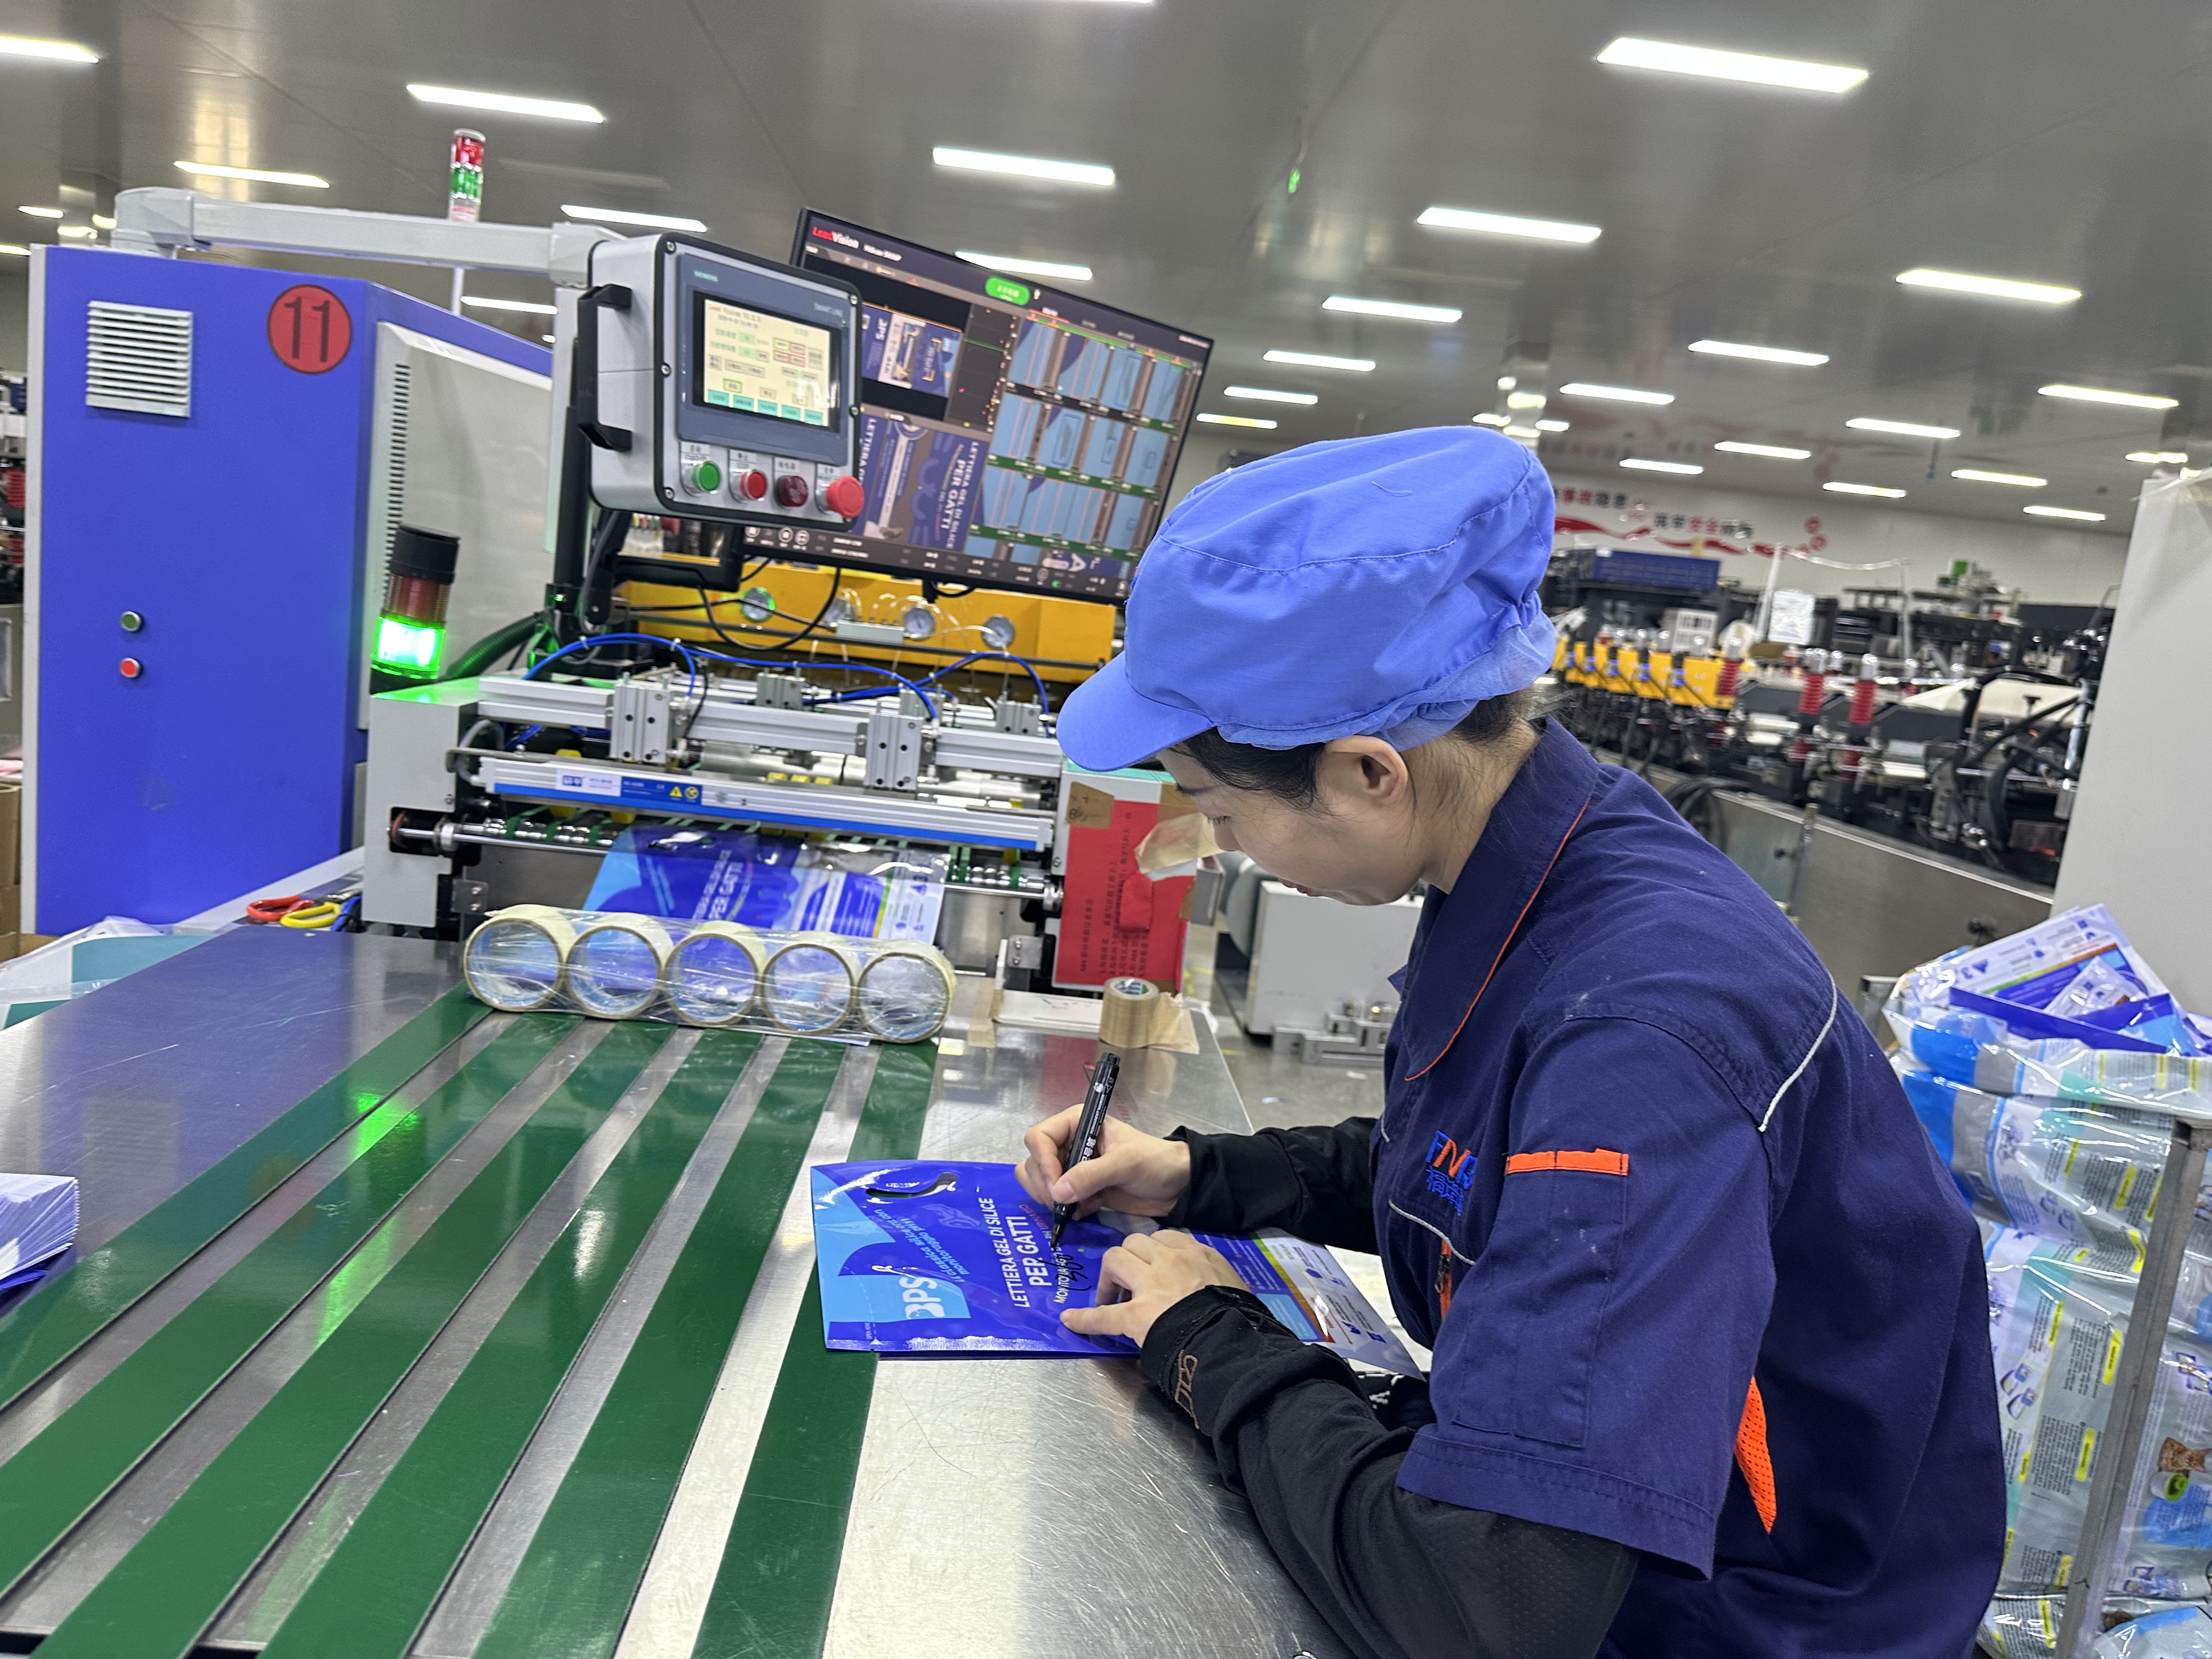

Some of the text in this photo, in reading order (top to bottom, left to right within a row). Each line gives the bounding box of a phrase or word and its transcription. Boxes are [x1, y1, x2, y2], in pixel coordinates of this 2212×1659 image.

[284, 297, 331, 363] 11
[874, 1209, 890, 1221] con
[888, 1217, 905, 1229] ora
[919, 1232, 970, 1275] monitoraggio
[978, 1197, 1030, 1307] LETTIERA GEL DI SILICE
[1006, 1216, 1052, 1286] PER GATTI
